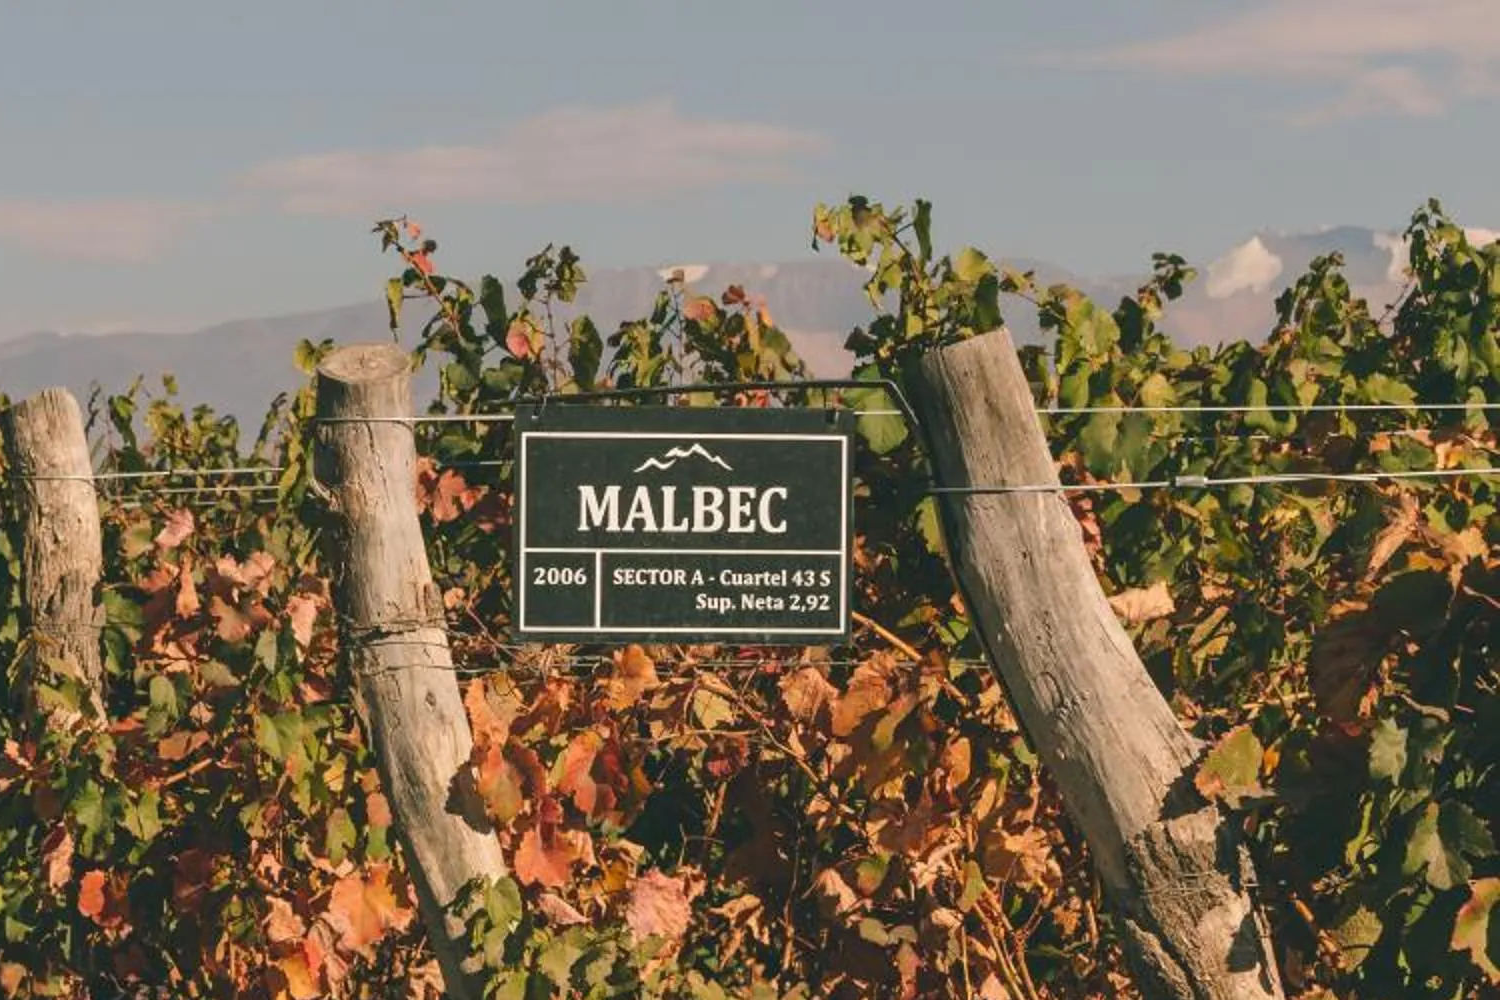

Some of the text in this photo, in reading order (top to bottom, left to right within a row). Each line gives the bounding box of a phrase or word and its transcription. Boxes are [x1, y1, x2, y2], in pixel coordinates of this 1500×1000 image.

[577, 485, 787, 533] MALBEC
[534, 567, 587, 585] 2006
[613, 568, 686, 585] SECTOR
[691, 569, 704, 586] A
[720, 569, 787, 586] Cuartel
[791, 570, 815, 587] 43
[820, 570, 830, 587] S
[696, 593, 830, 614] Sup. Neta 2,92
